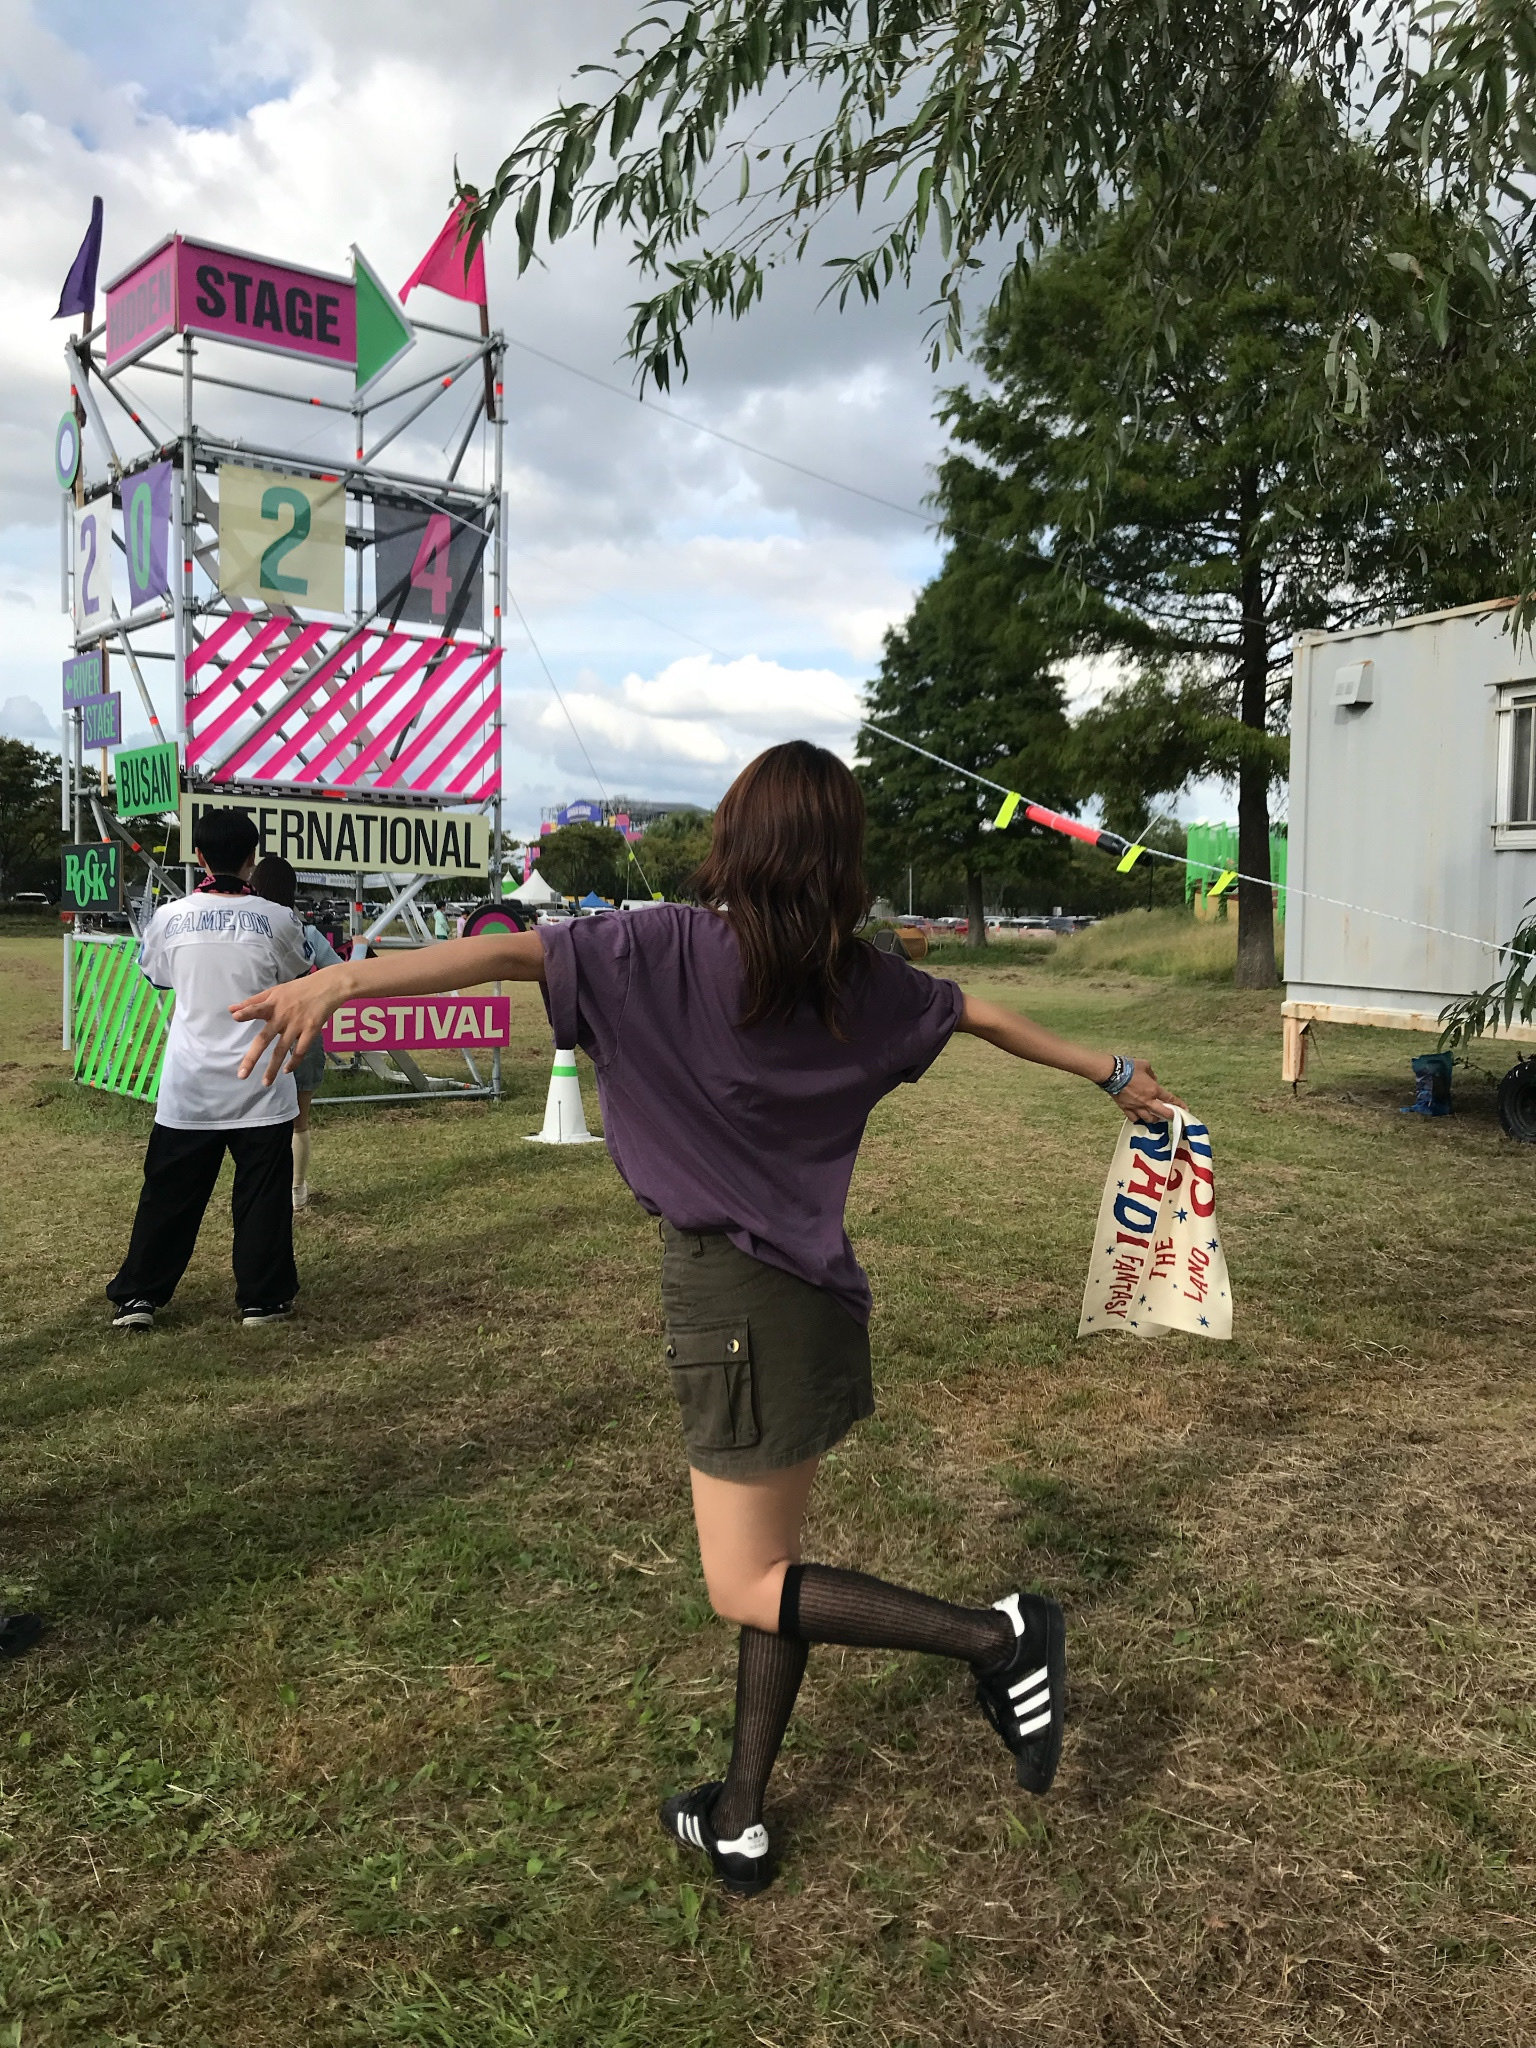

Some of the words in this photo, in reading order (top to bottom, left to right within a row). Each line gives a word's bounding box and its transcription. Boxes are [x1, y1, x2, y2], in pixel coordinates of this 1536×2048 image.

[109, 263, 171, 352] HIDDEN
[195, 265, 341, 346] STAGE
[80, 514, 99, 616] 2
[129, 482, 153, 590] 0
[259, 486, 312, 595] 2
[410, 513, 453, 615] 4
[73, 657, 100, 700] RIVER
[86, 700, 117, 743] STAGE
[120, 752, 173, 809] BUSAN
[191, 802, 481, 869] IERNATIONAL
[65, 847, 117, 908] ROCK!
[164, 909, 236, 939] GAME
[238, 910, 273, 939] ON
[322, 1005, 504, 1043] ESTIVAL
[1104, 1253, 1145, 1319] FANTASY
[1148, 1236, 1177, 1281] THE
[1183, 1246, 1211, 1304] LAND
